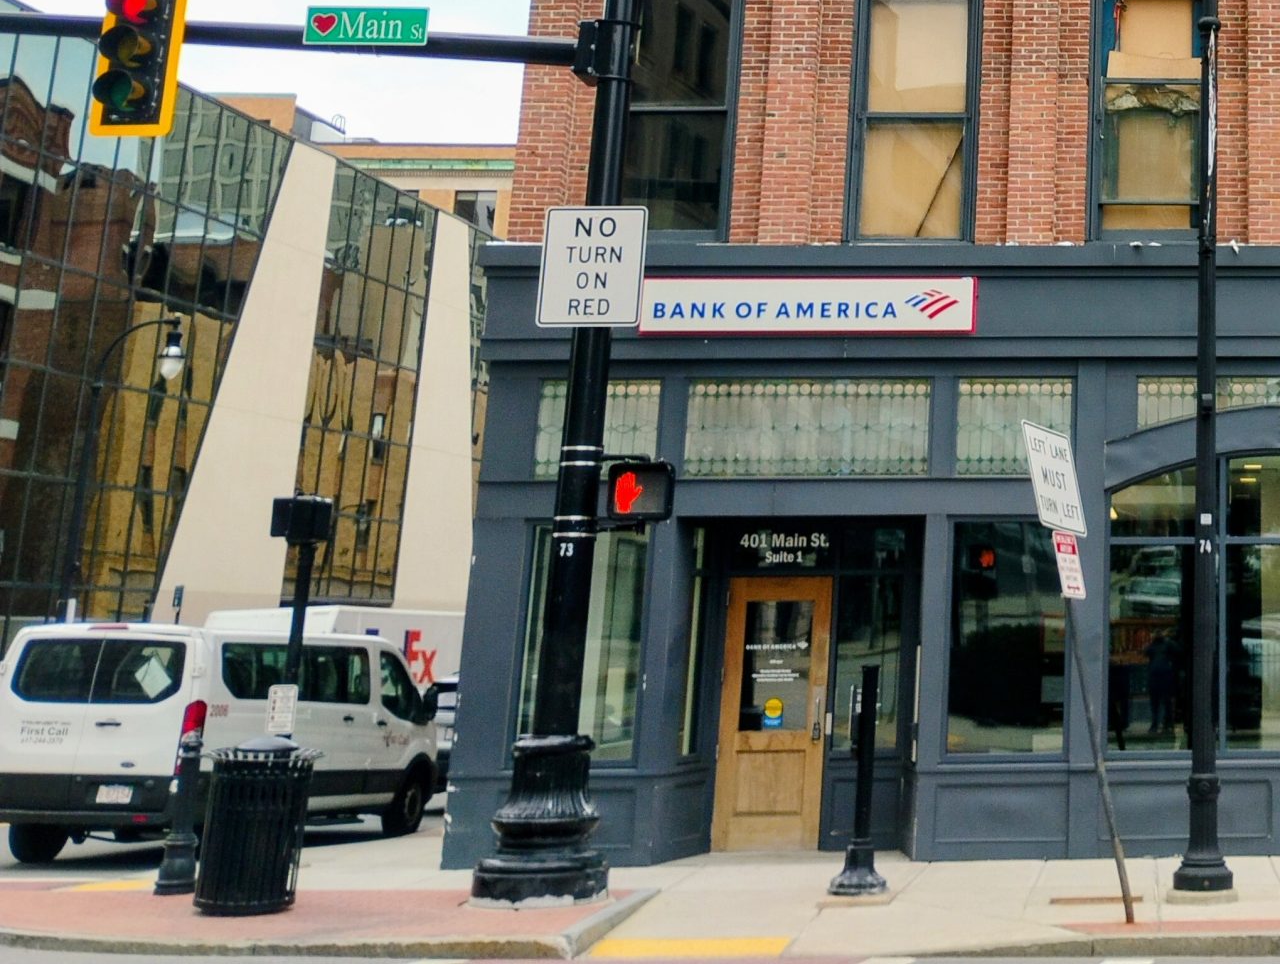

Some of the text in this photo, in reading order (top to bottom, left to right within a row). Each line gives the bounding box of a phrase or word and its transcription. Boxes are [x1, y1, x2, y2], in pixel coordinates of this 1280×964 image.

[338, 11, 423, 39] Main St
[575, 217, 617, 237] NO
[566, 246, 622, 263] TURN
[576, 272, 607, 289] ON
[568, 299, 610, 315] RED
[653, 302, 898, 319] BANK OF AMERICA
[1029, 436, 1070, 463] LEFT LANE
[1041, 466, 1067, 491] MUST
[1040, 494, 1080, 520] TURN LEFT
[740, 532, 830, 548] 401 Main St.
[560, 542, 574, 557] 73
[765, 550, 803, 563] Suite 1
[20, 726, 69, 736] First Call
